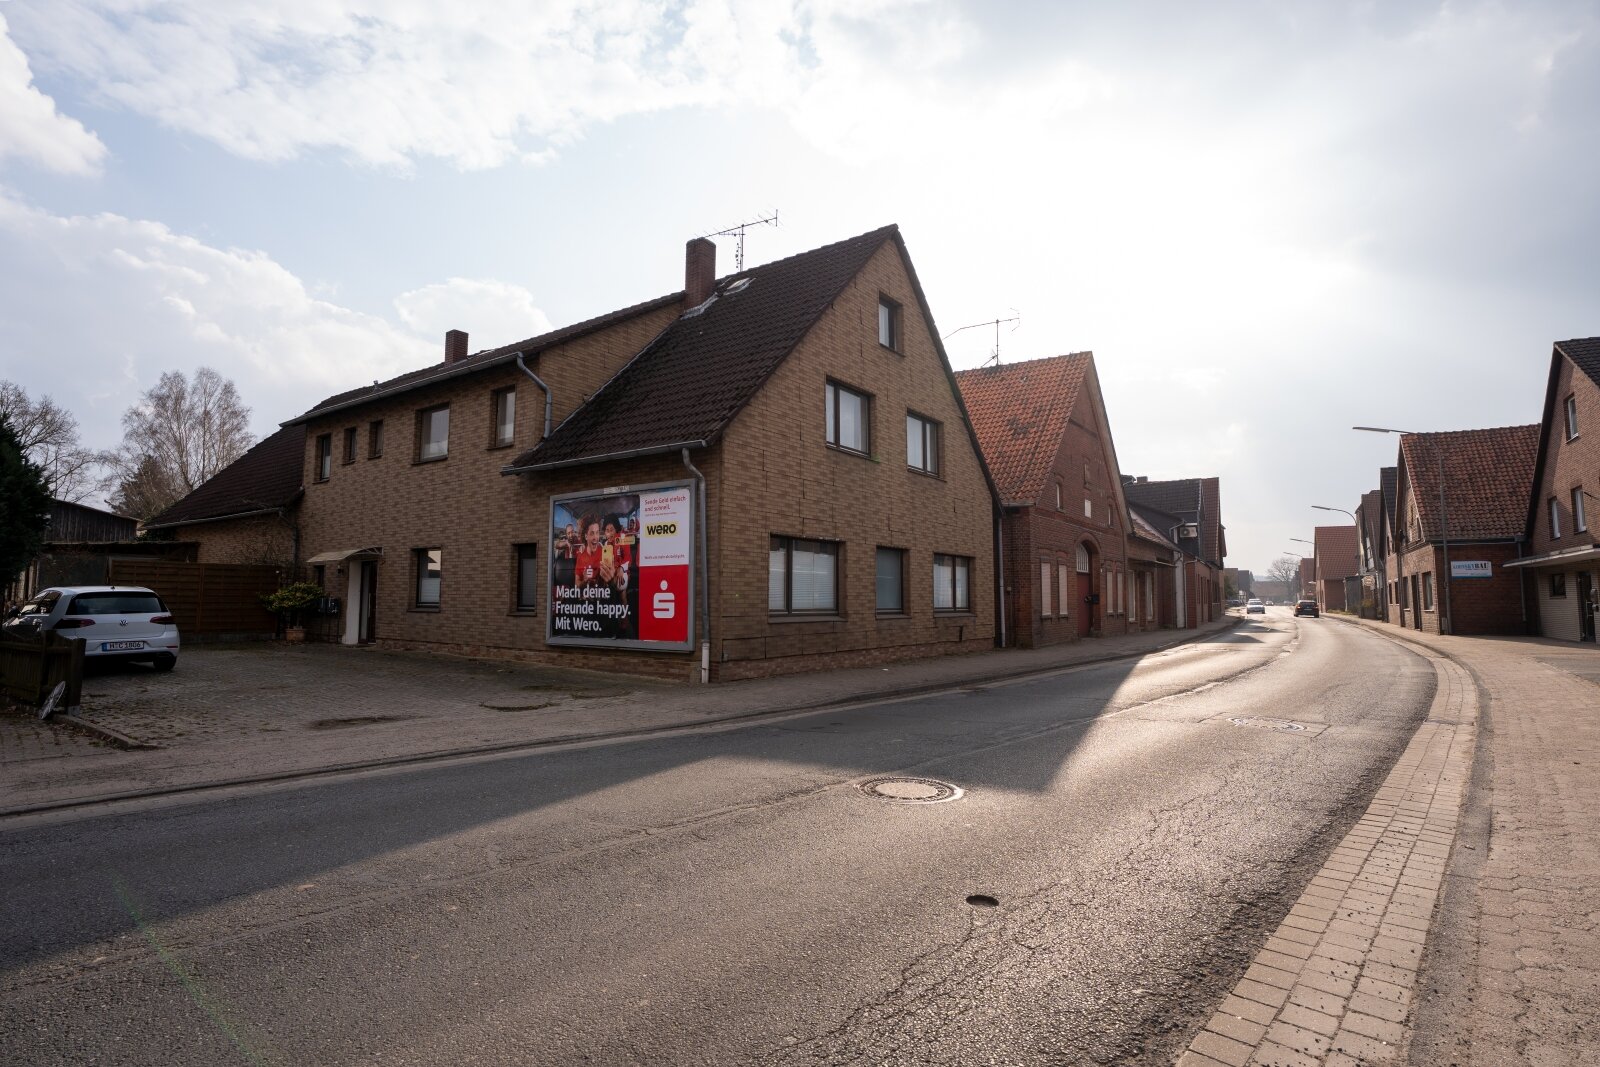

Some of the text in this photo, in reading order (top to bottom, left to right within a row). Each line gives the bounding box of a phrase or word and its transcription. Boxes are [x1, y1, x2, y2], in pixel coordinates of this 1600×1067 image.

[556, 583, 610, 599] Mach deine
[555, 601, 594, 614] Freunde
[597, 601, 631, 618] happy.
[555, 616, 602, 631] Mit Wero.
